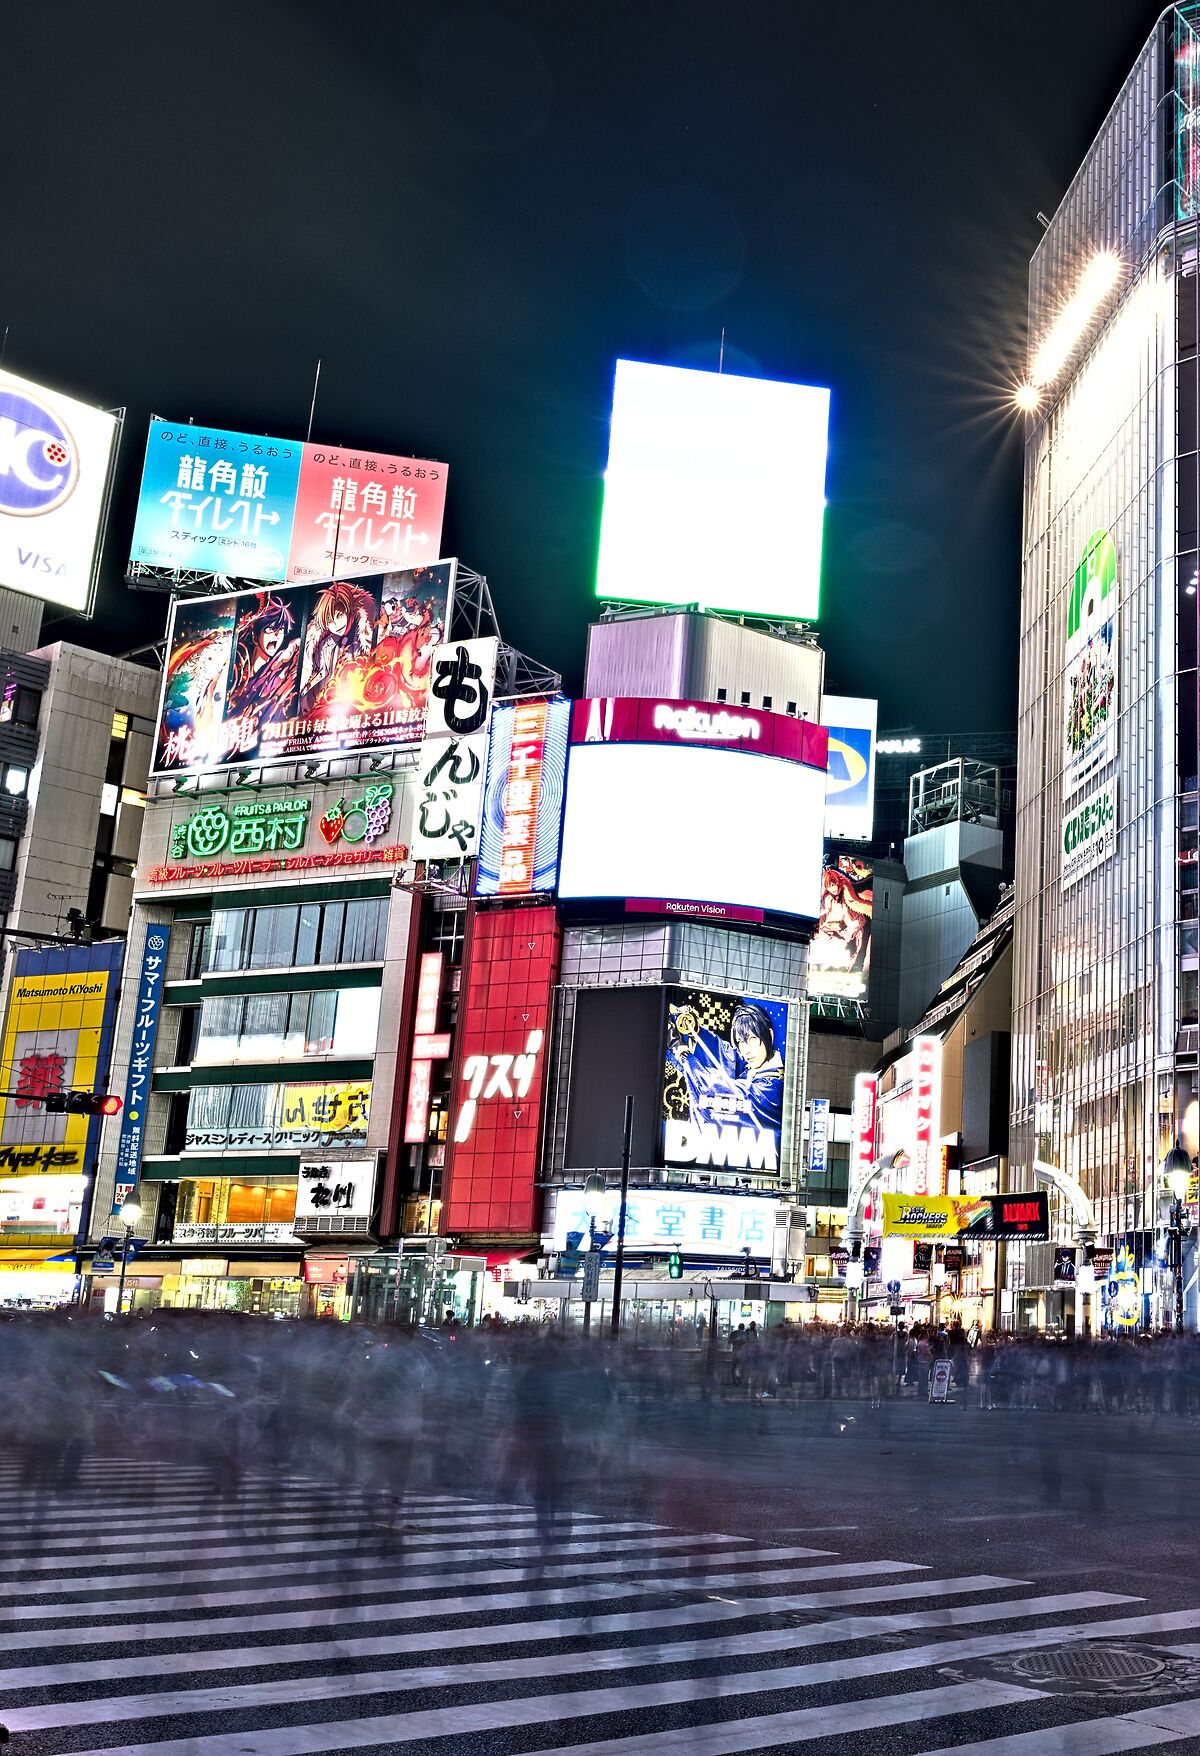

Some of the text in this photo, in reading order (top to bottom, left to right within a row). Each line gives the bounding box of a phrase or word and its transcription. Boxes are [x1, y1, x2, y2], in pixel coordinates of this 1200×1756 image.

[161, 430, 292, 459] のど、直接、うるおう
[176, 453, 270, 499] 龍角散
[313, 453, 440, 480] のど、直接、うるおう
[330, 476, 417, 520] 龍角散
[17, 547, 68, 577] VISA
[654, 704, 760, 740] Rakuten
[418, 645, 489, 852] もんじゃ
[170, 823, 187, 860] 渋谷
[229, 814, 307, 855] 西村
[666, 901, 726, 915] Rakuten Vision
[16, 983, 103, 998] Matsumoto KiYoshi
[131, 955, 162, 1105] サマーフルーツギフト
[15, 1053, 66, 1109] 薬
